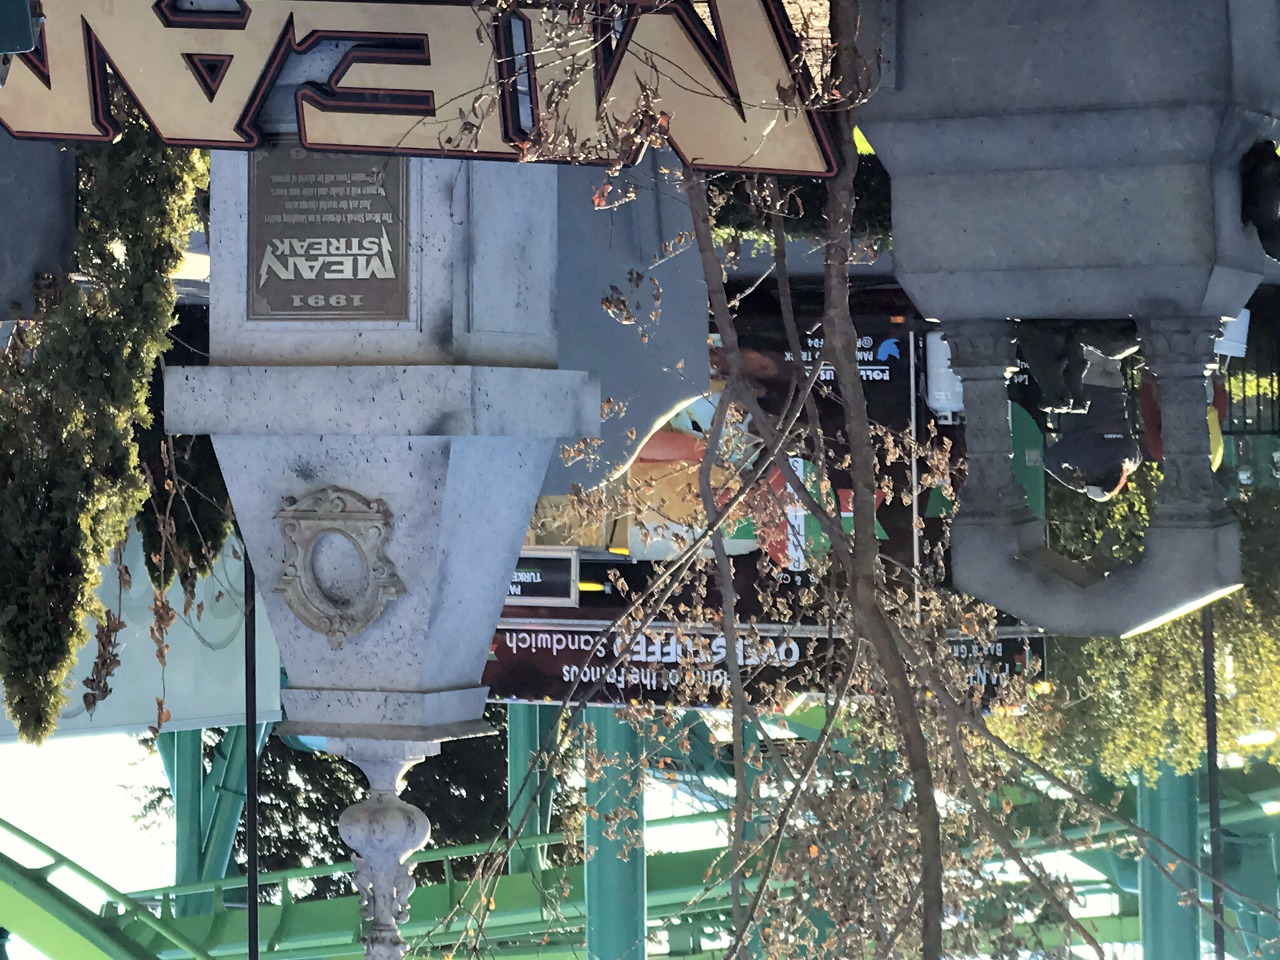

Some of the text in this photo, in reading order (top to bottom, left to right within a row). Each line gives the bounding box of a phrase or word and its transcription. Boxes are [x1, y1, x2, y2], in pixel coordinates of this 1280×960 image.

[271, 237, 380, 256] STREAK
[290, 294, 364, 308] 1991
[512, 571, 542, 583] TURKE
[505, 631, 606, 658] Sandwich
[561, 664, 625, 689] Famous
[629, 665, 657, 691] the
